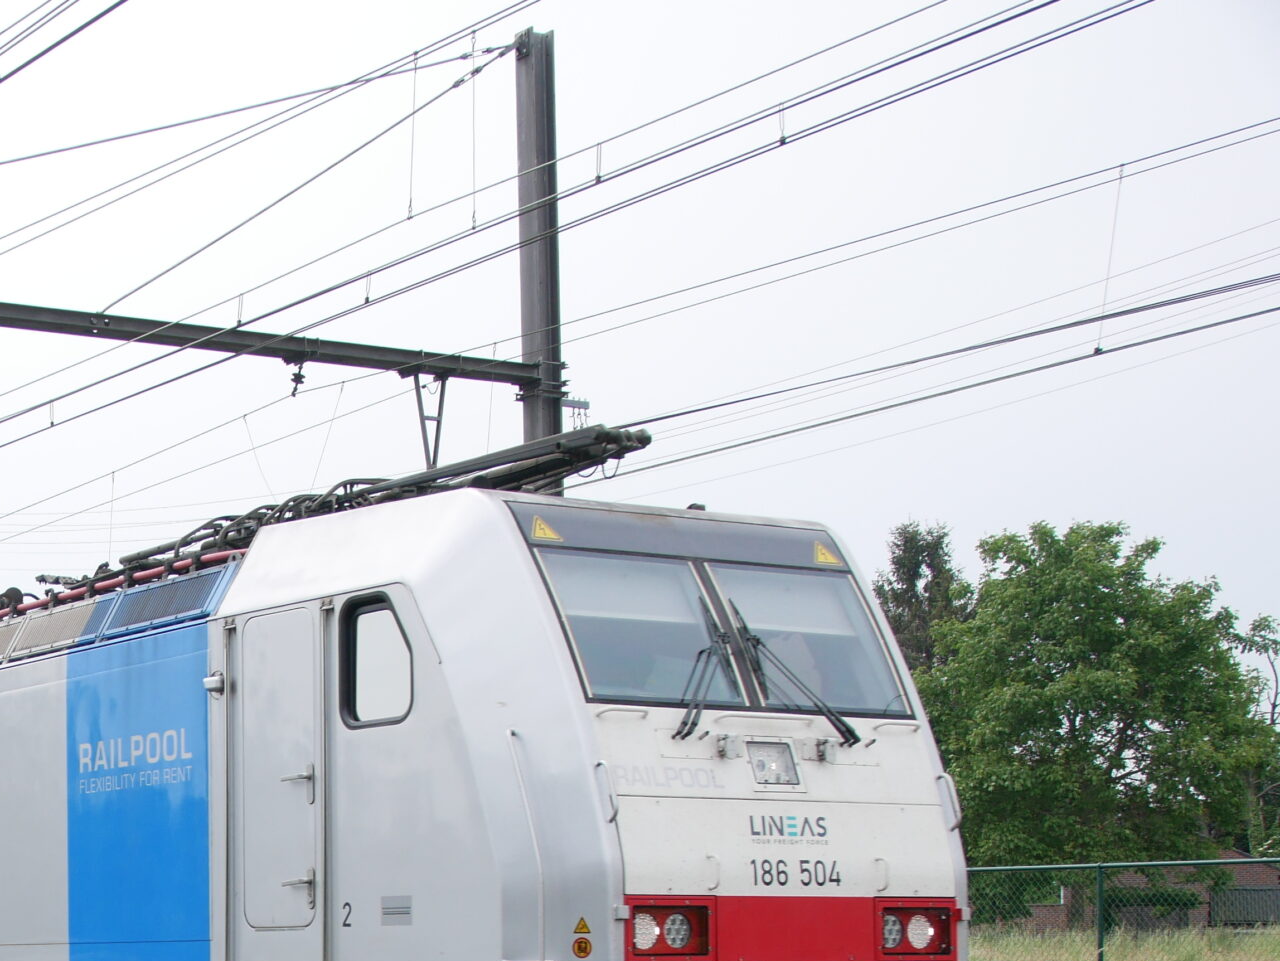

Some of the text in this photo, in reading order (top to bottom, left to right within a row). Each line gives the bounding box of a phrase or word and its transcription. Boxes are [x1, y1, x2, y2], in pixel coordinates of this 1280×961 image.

[79, 728, 193, 773] RAILPOOL
[79, 766, 193, 794] FLEXIBILITY FOR RENT
[610, 764, 725, 789] RAILPOOL
[749, 815, 827, 837] LINEAS
[773, 838, 804, 846] FREIGHT
[750, 859, 842, 887] 186 504
[342, 902, 352, 928] 2
